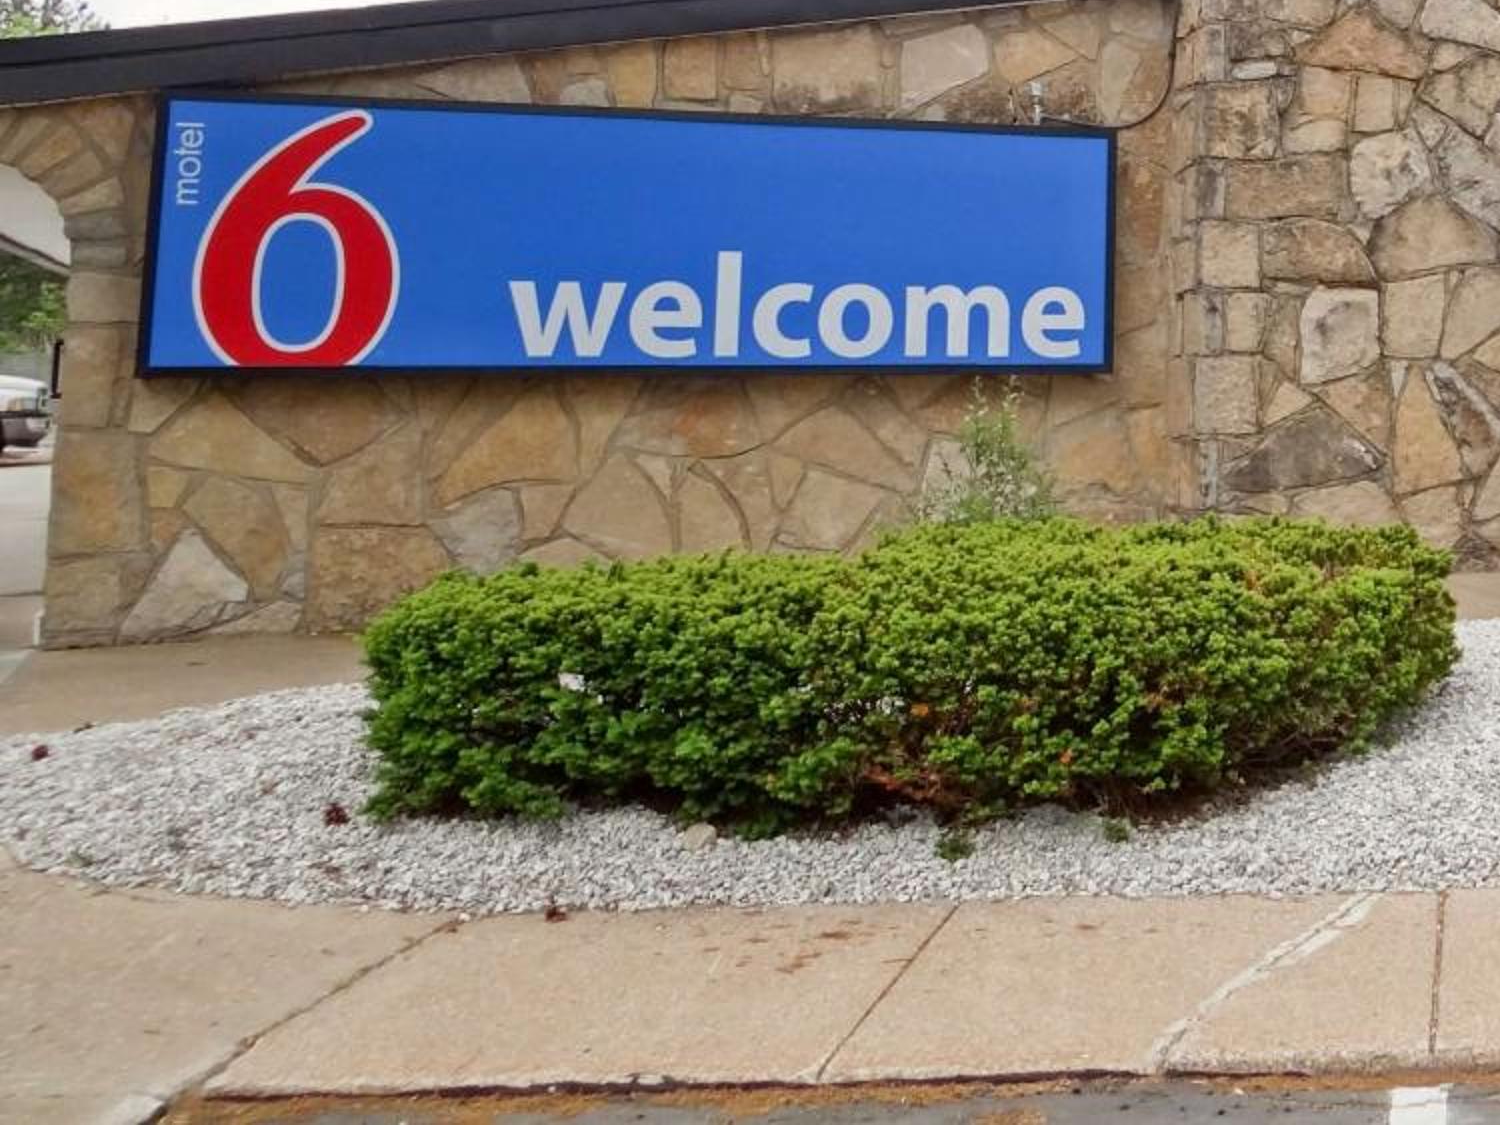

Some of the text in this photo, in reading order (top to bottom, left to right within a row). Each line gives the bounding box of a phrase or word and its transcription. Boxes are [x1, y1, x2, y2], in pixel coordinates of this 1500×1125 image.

[175, 110, 399, 366] motel 6
[509, 251, 1085, 357] welcome
